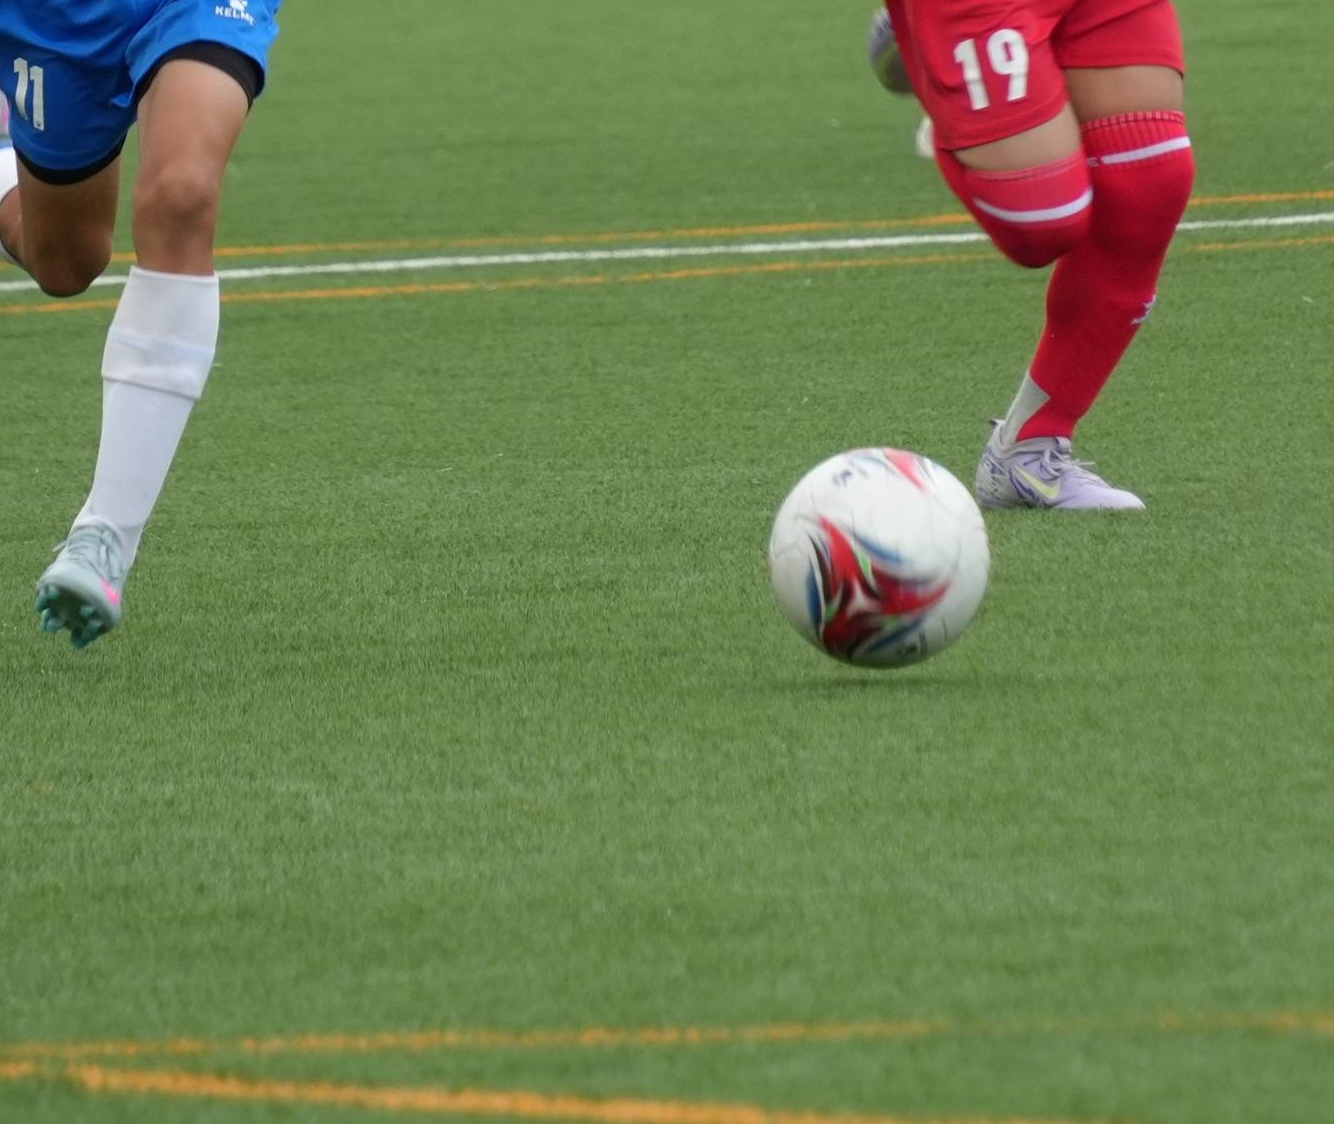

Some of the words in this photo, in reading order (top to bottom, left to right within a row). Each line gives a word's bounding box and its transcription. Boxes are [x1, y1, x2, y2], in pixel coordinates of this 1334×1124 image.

[214, 5, 256, 26] KELME
[13, 57, 45, 131] 11
[953, 28, 1030, 111] 19
